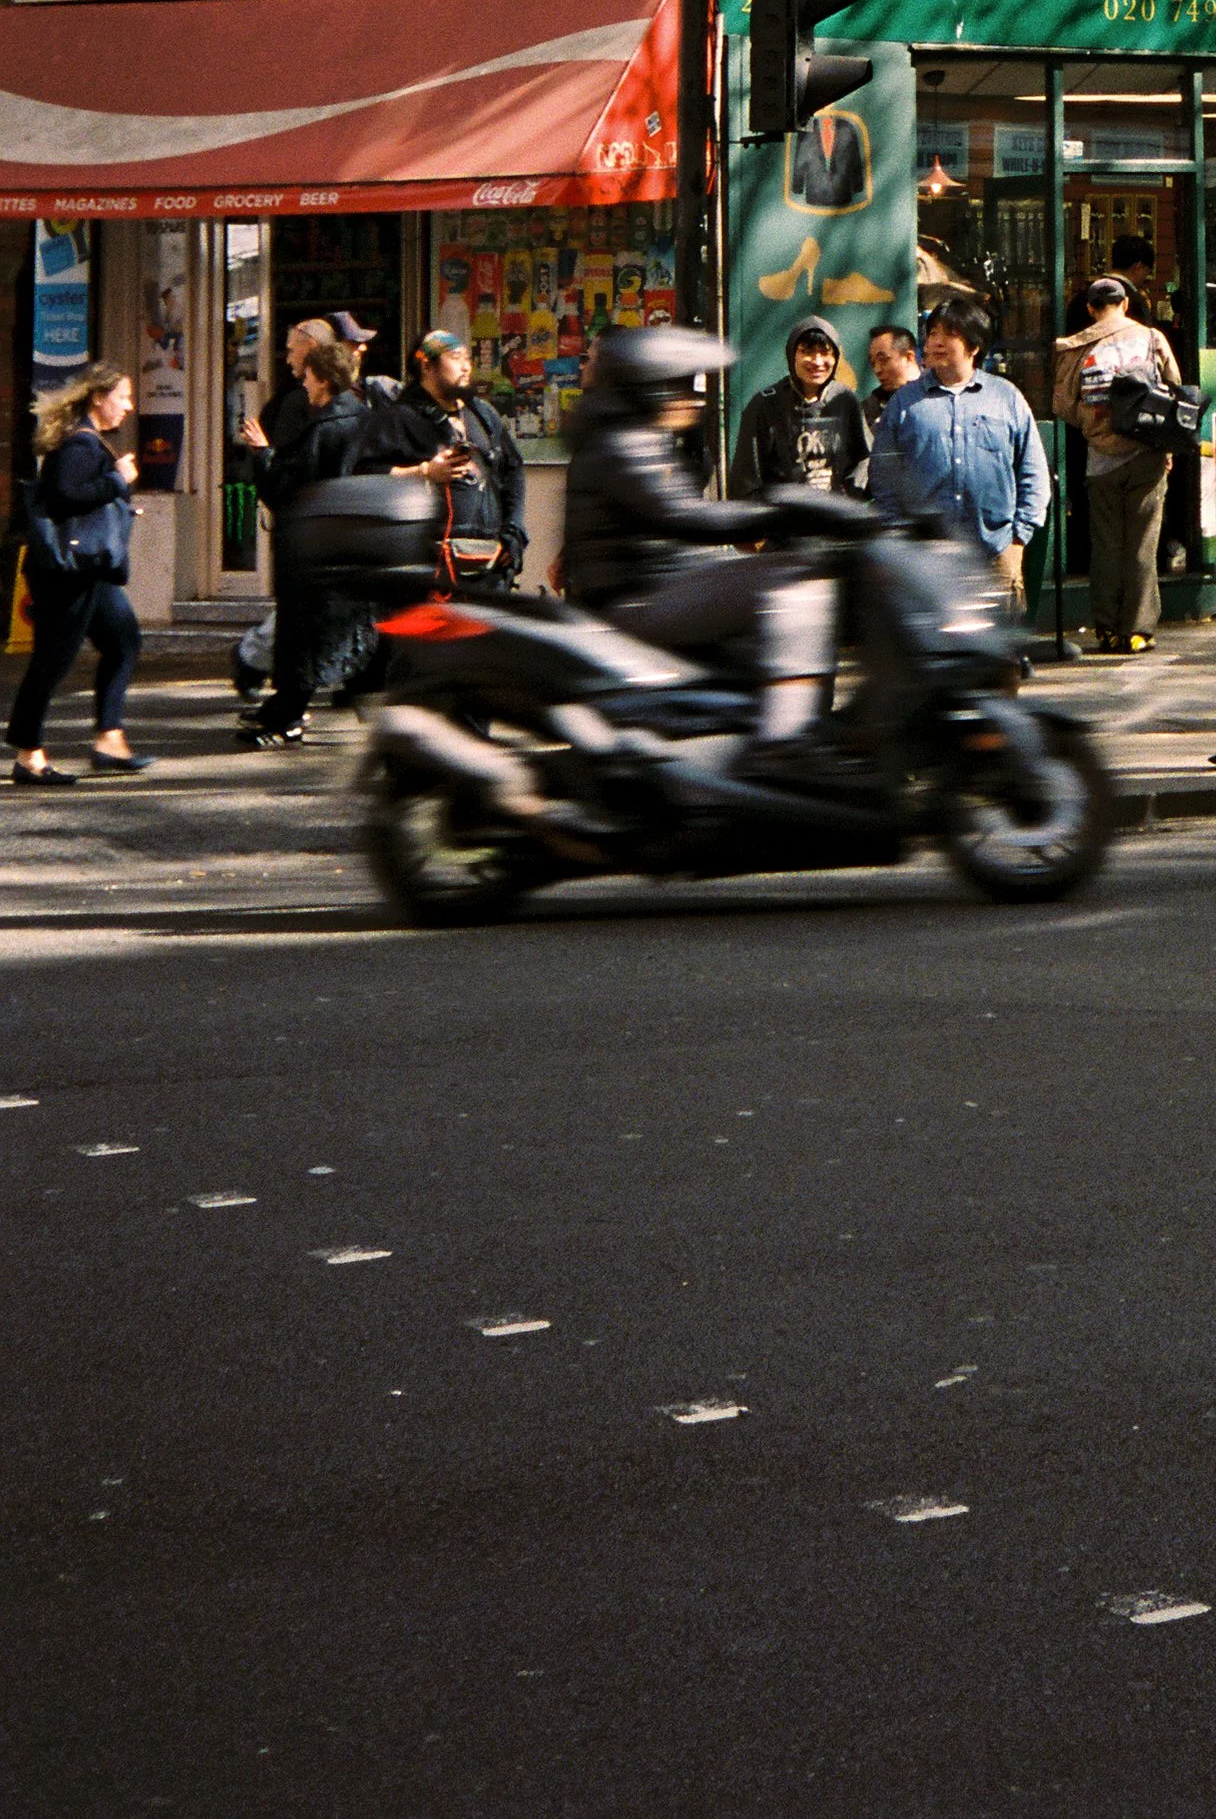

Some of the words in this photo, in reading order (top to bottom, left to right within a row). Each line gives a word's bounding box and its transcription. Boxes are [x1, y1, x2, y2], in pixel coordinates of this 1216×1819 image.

[0, 197, 37, 211] TTES
[54, 196, 138, 211] MAGAZINES
[154, 196, 198, 210] FOOD
[213, 193, 284, 209] GROCERY
[299, 192, 340, 206] BEER
[44, 327, 80, 343] HERE
